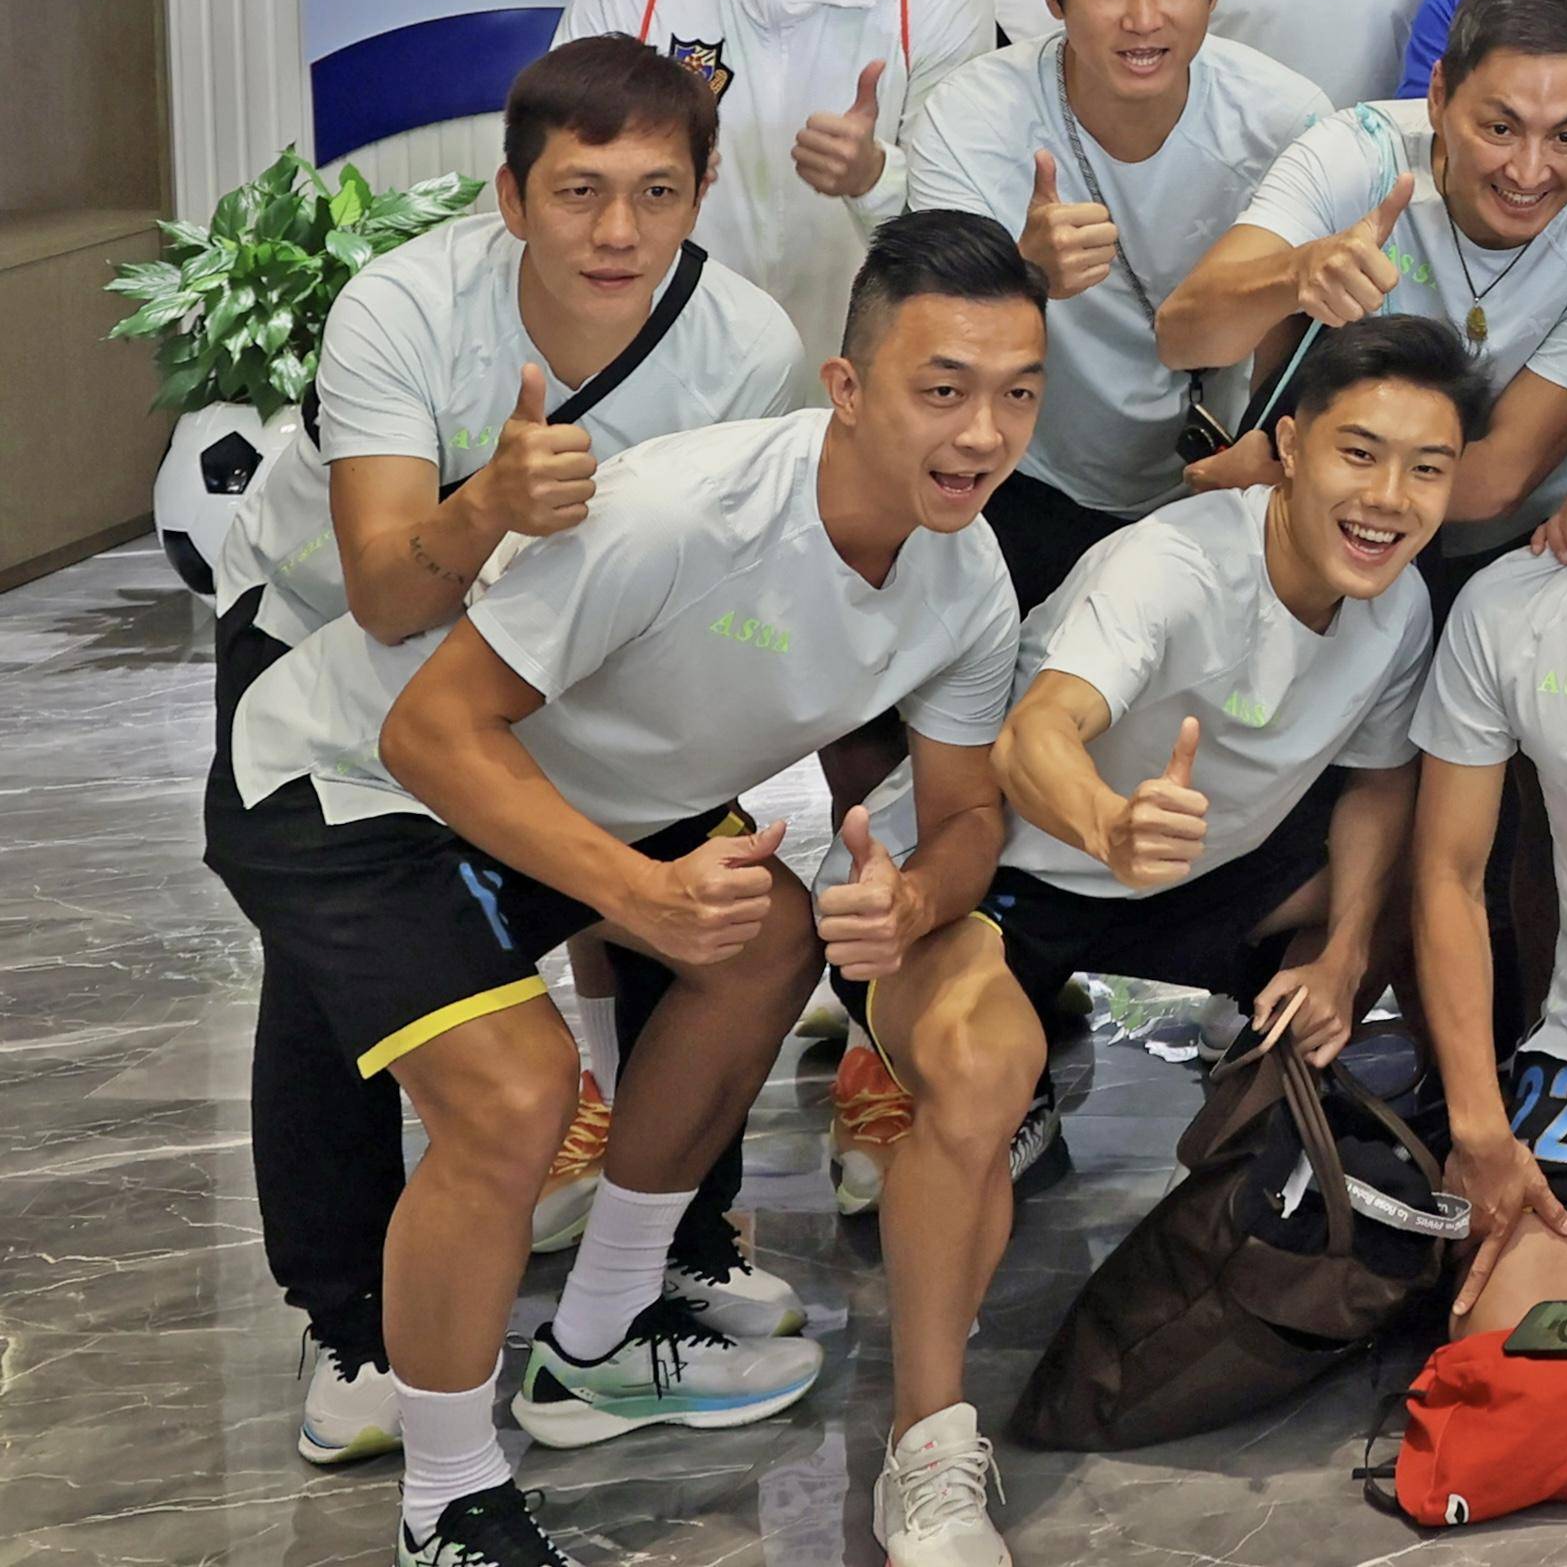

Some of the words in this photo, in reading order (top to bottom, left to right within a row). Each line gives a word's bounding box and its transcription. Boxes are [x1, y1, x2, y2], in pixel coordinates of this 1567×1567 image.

[448, 426, 501, 451] AS
[709, 610, 792, 655] ASSA
[1223, 691, 1274, 730] ASS
